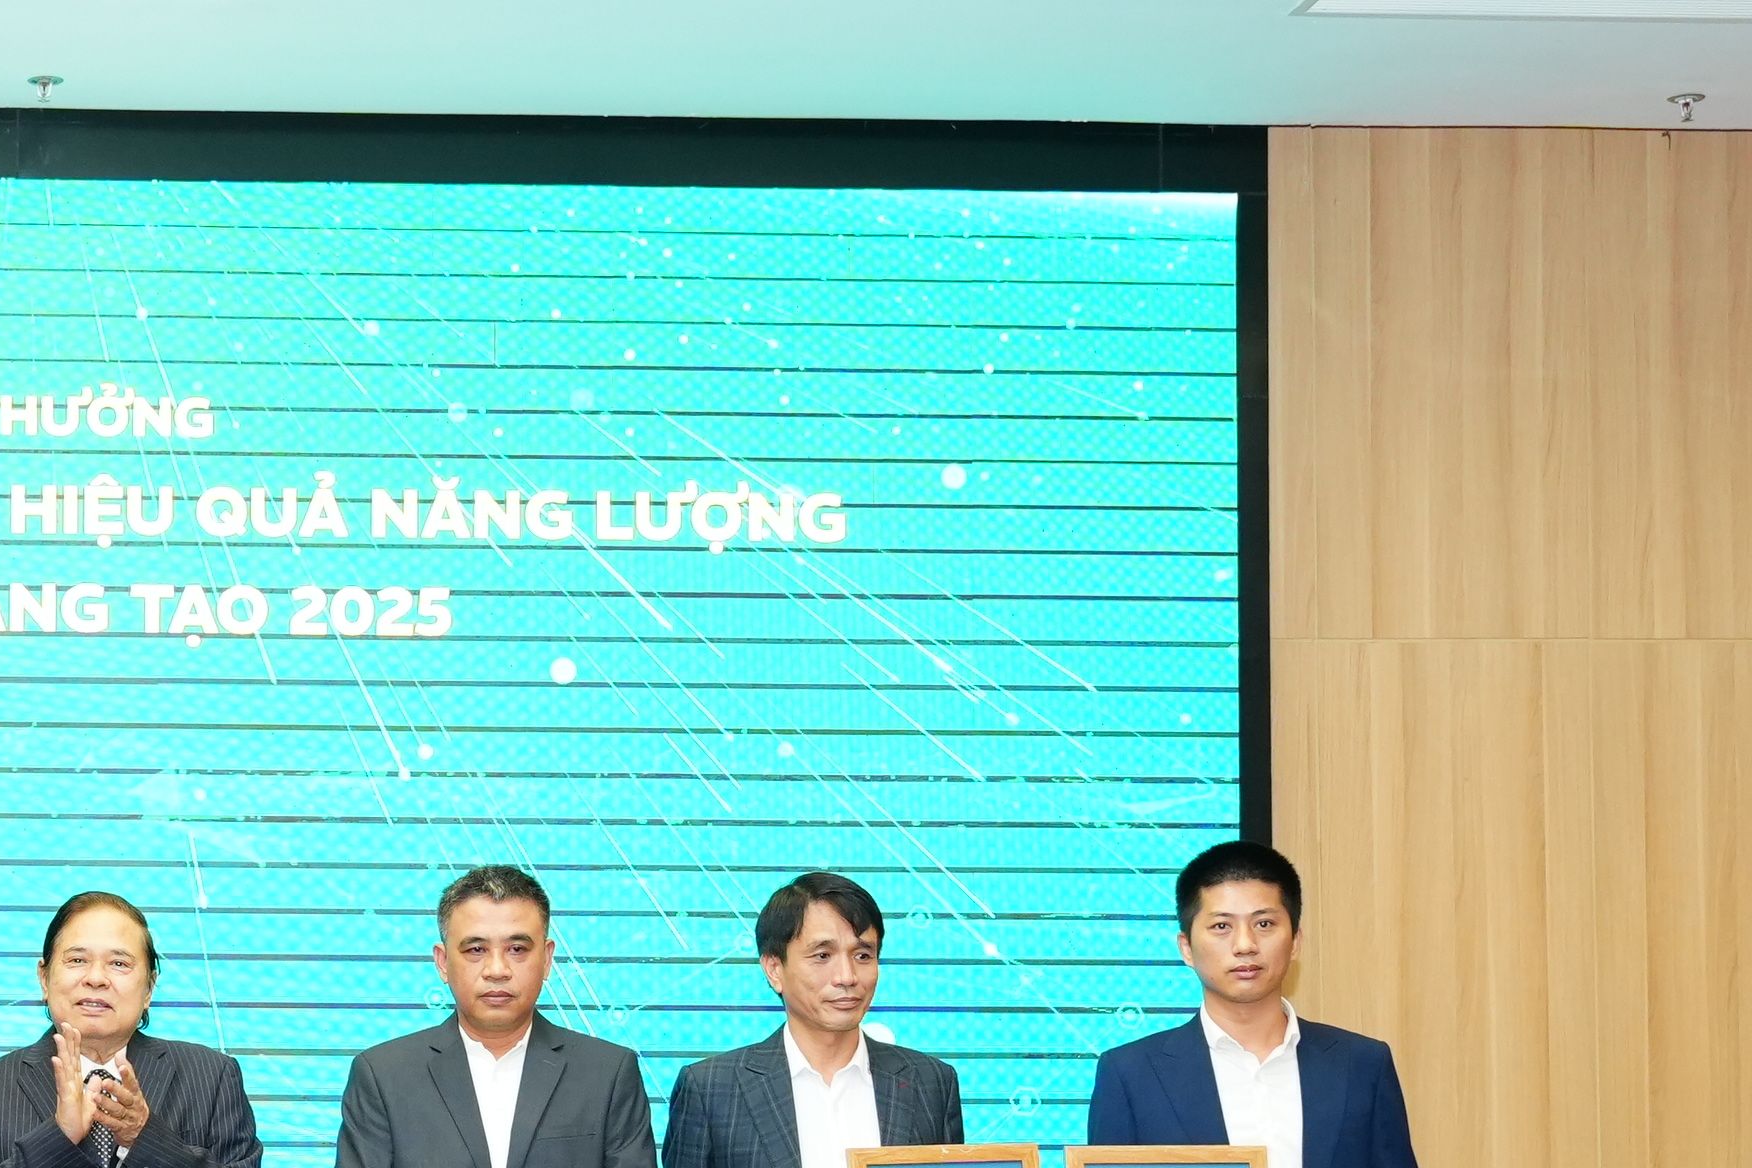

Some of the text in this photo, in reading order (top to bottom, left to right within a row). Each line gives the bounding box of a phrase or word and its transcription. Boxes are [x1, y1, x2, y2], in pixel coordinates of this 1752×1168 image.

[10, 473, 174, 549] HIỆU
[195, 470, 349, 540] QUẢ
[371, 474, 573, 541] NĂNG
[596, 479, 846, 555] LƯỢNG
[129, 582, 269, 648] TẠO
[289, 583, 452, 637] 2025
